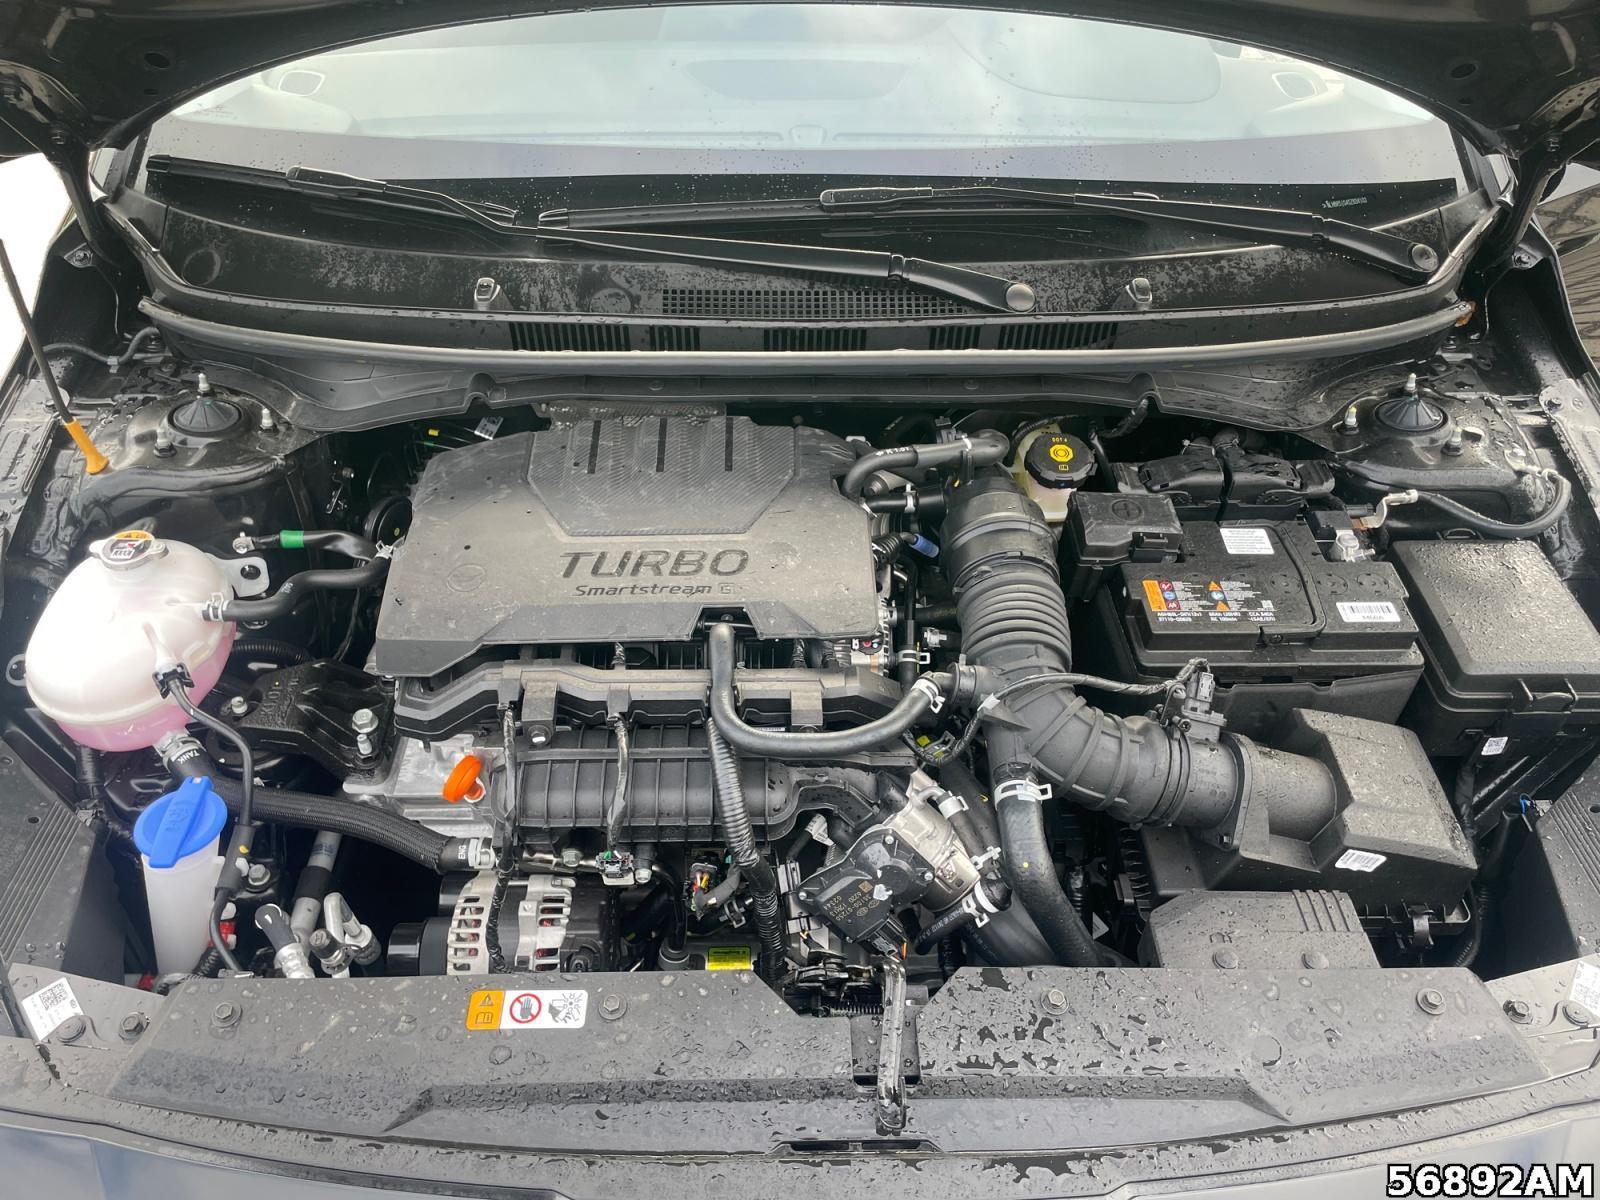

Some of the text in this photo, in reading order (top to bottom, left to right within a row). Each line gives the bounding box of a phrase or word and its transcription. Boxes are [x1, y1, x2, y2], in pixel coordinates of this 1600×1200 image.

[560, 549, 749, 578] TURBO
[575, 583, 712, 597] Smartstream
[177, 750, 200, 765] TANK
[457, 845, 467, 860] ENG
